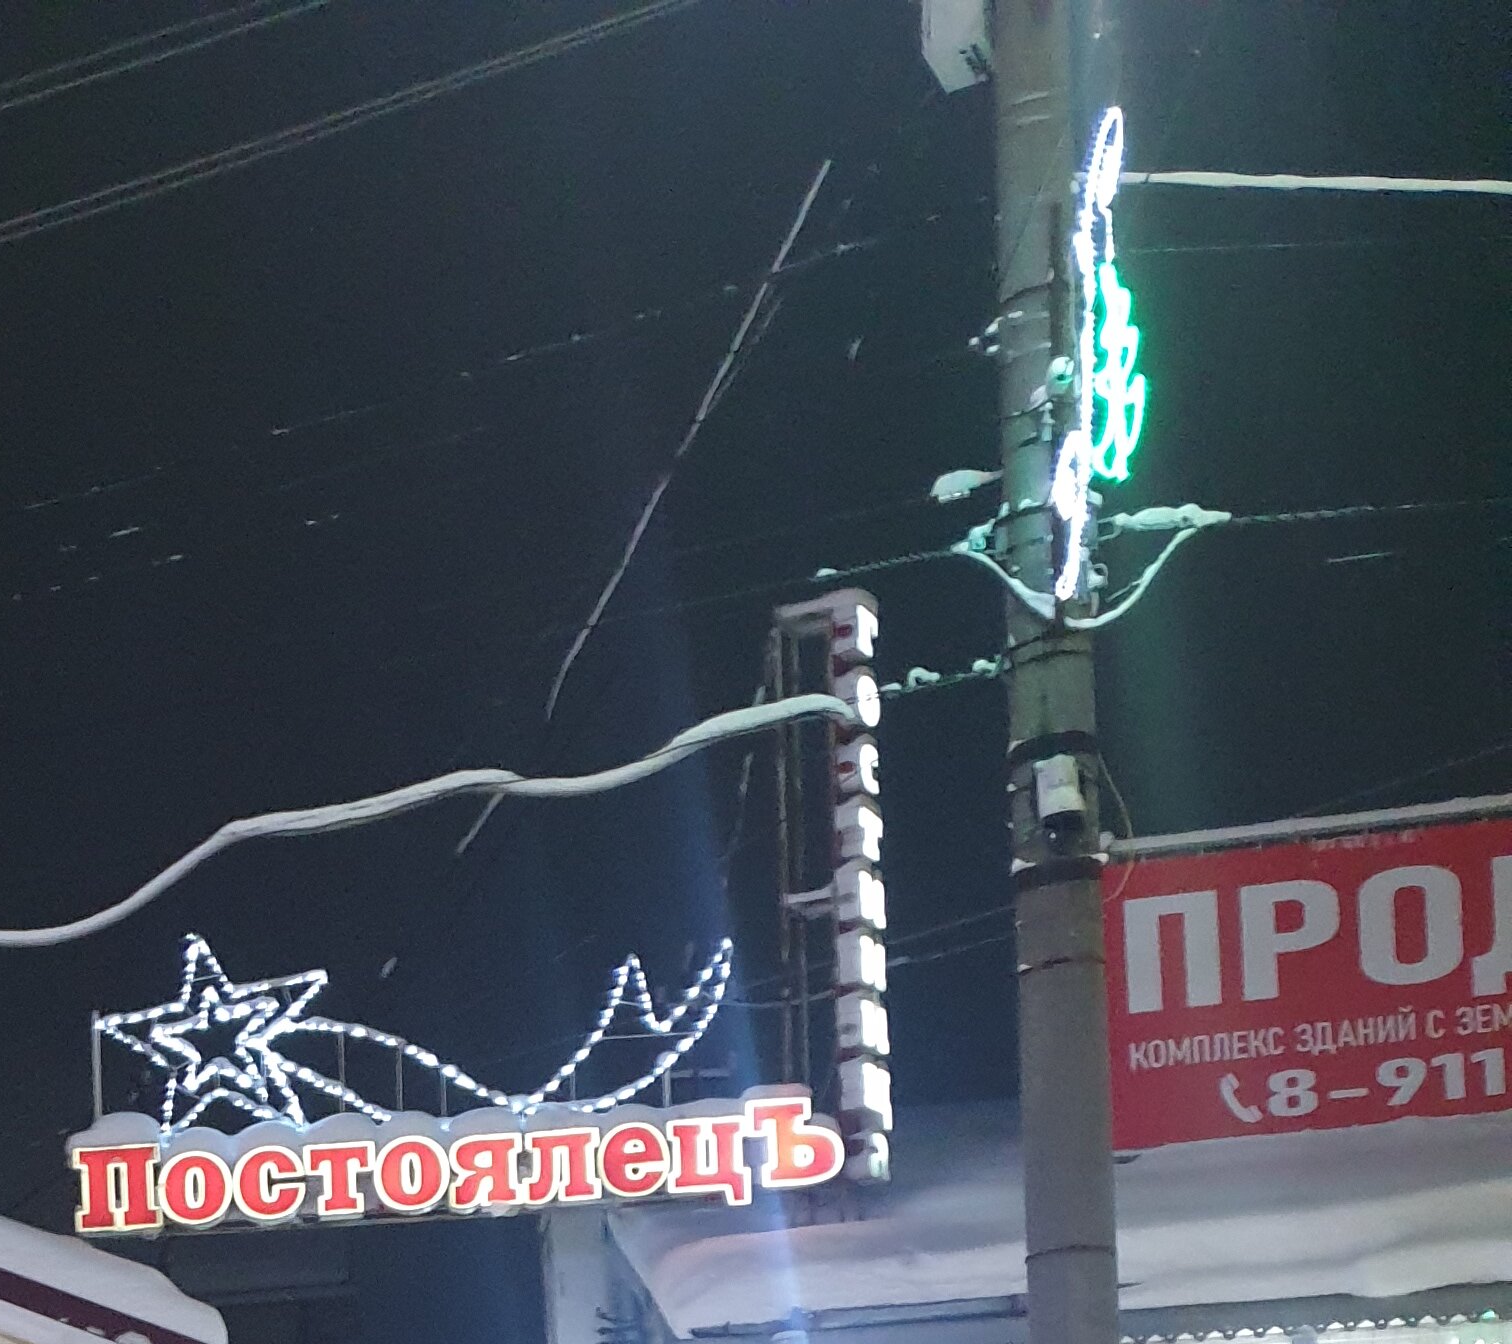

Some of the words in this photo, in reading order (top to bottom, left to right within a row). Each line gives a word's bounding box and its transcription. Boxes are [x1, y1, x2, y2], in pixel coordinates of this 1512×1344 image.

[1129, 1027, 1285, 1071] КОМПЛЕКС
[1294, 1006, 1416, 1054] ЗДАНИЙ
[1425, 1009, 1446, 1039] С
[1266, 1047, 1506, 1118] 8-911
